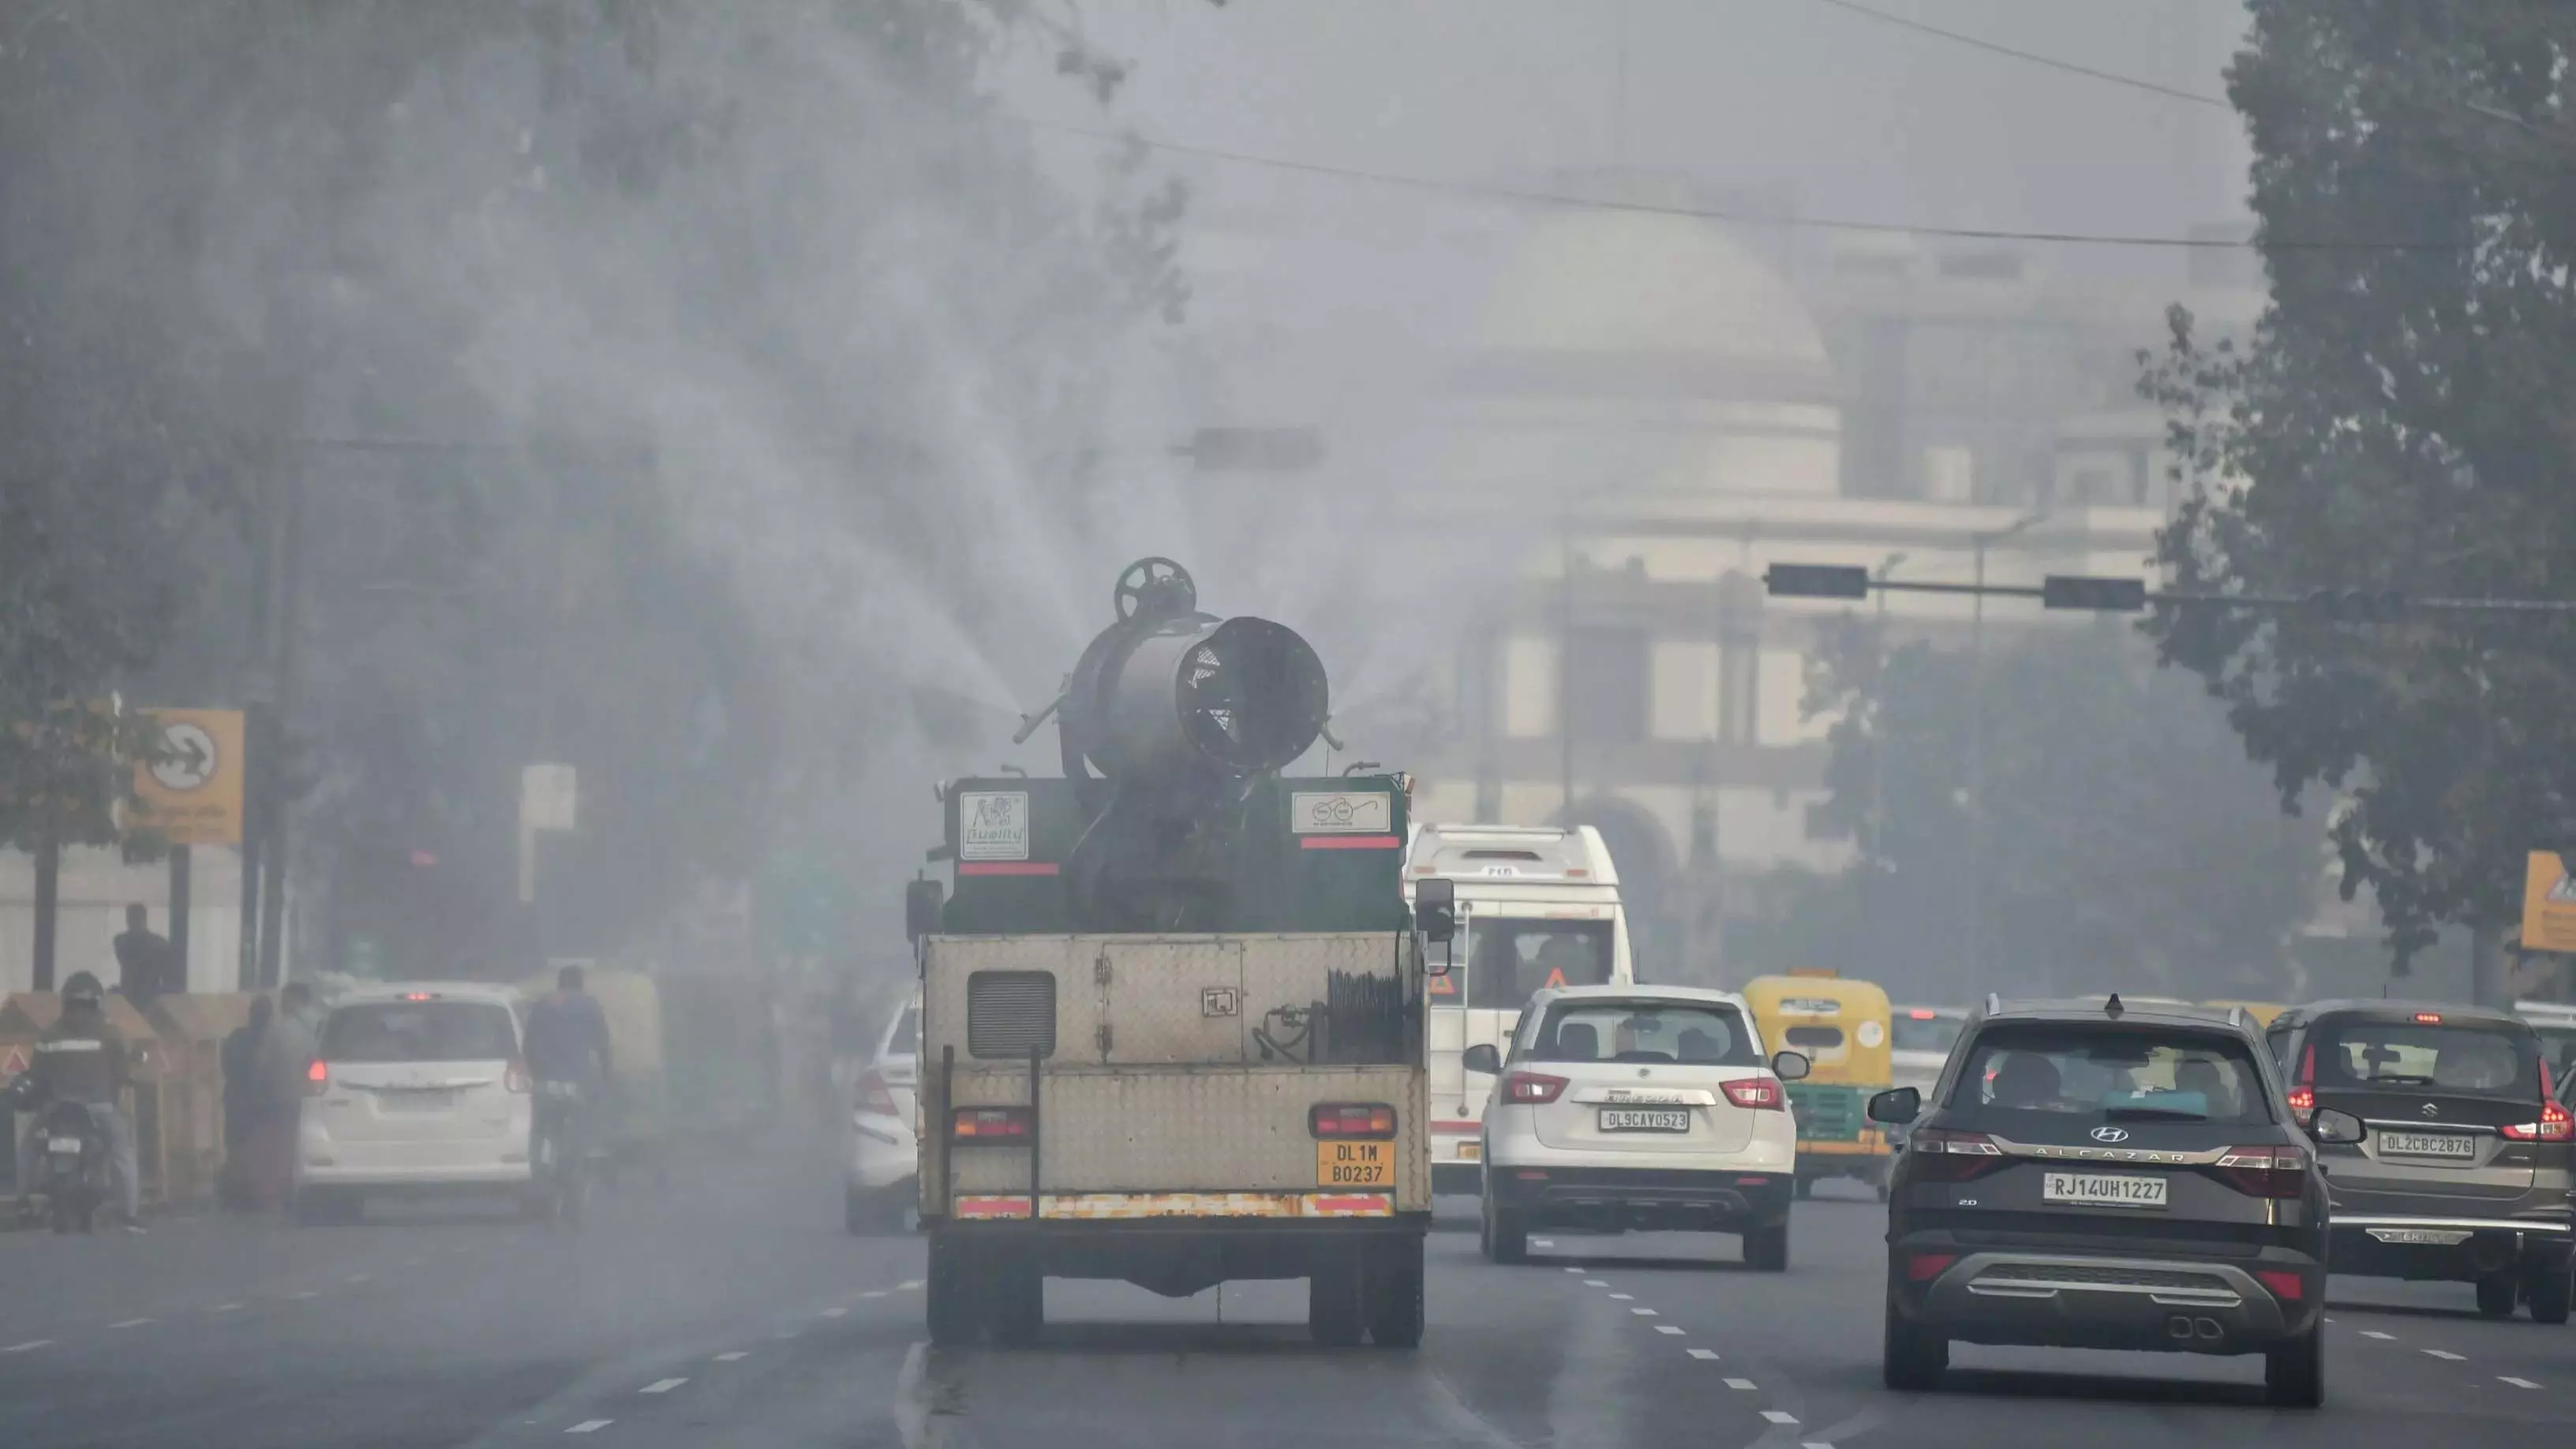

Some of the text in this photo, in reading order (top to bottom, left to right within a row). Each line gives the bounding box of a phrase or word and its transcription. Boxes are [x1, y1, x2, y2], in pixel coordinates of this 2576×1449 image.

[1337, 1144, 1377, 1161] DL1M
[2035, 1148, 2184, 1163] ALCAZAR
[1333, 1166, 1383, 1181] B0237
[2055, 1178, 2163, 1200] RJ14UH1227
